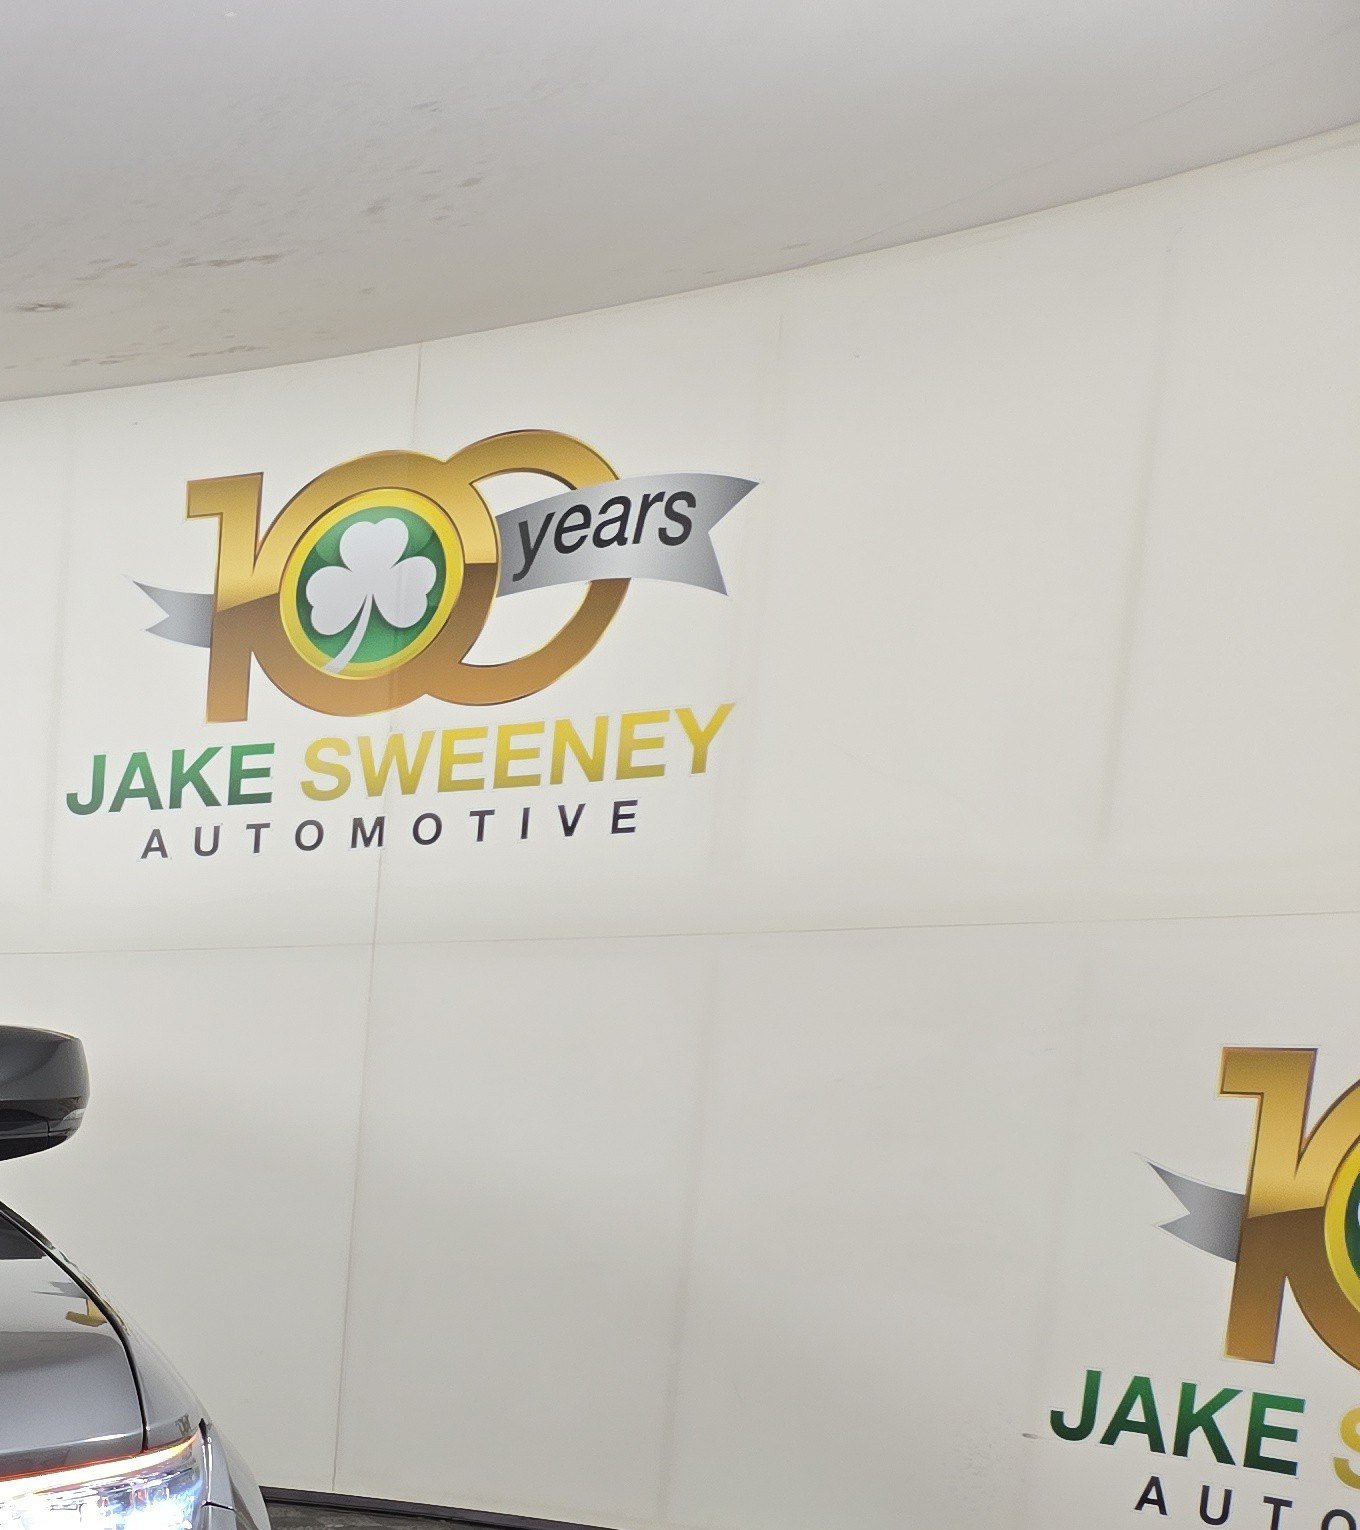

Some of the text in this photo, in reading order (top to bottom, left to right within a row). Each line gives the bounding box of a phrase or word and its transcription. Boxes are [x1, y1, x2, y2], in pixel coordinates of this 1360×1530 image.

[186, 429, 631, 723] 100
[513, 487, 697, 580] years
[65, 703, 736, 815] JAKE SWEENEY
[141, 800, 638, 859] AUTOMOTIVE
[1050, 1370, 1305, 1476] JAKE
